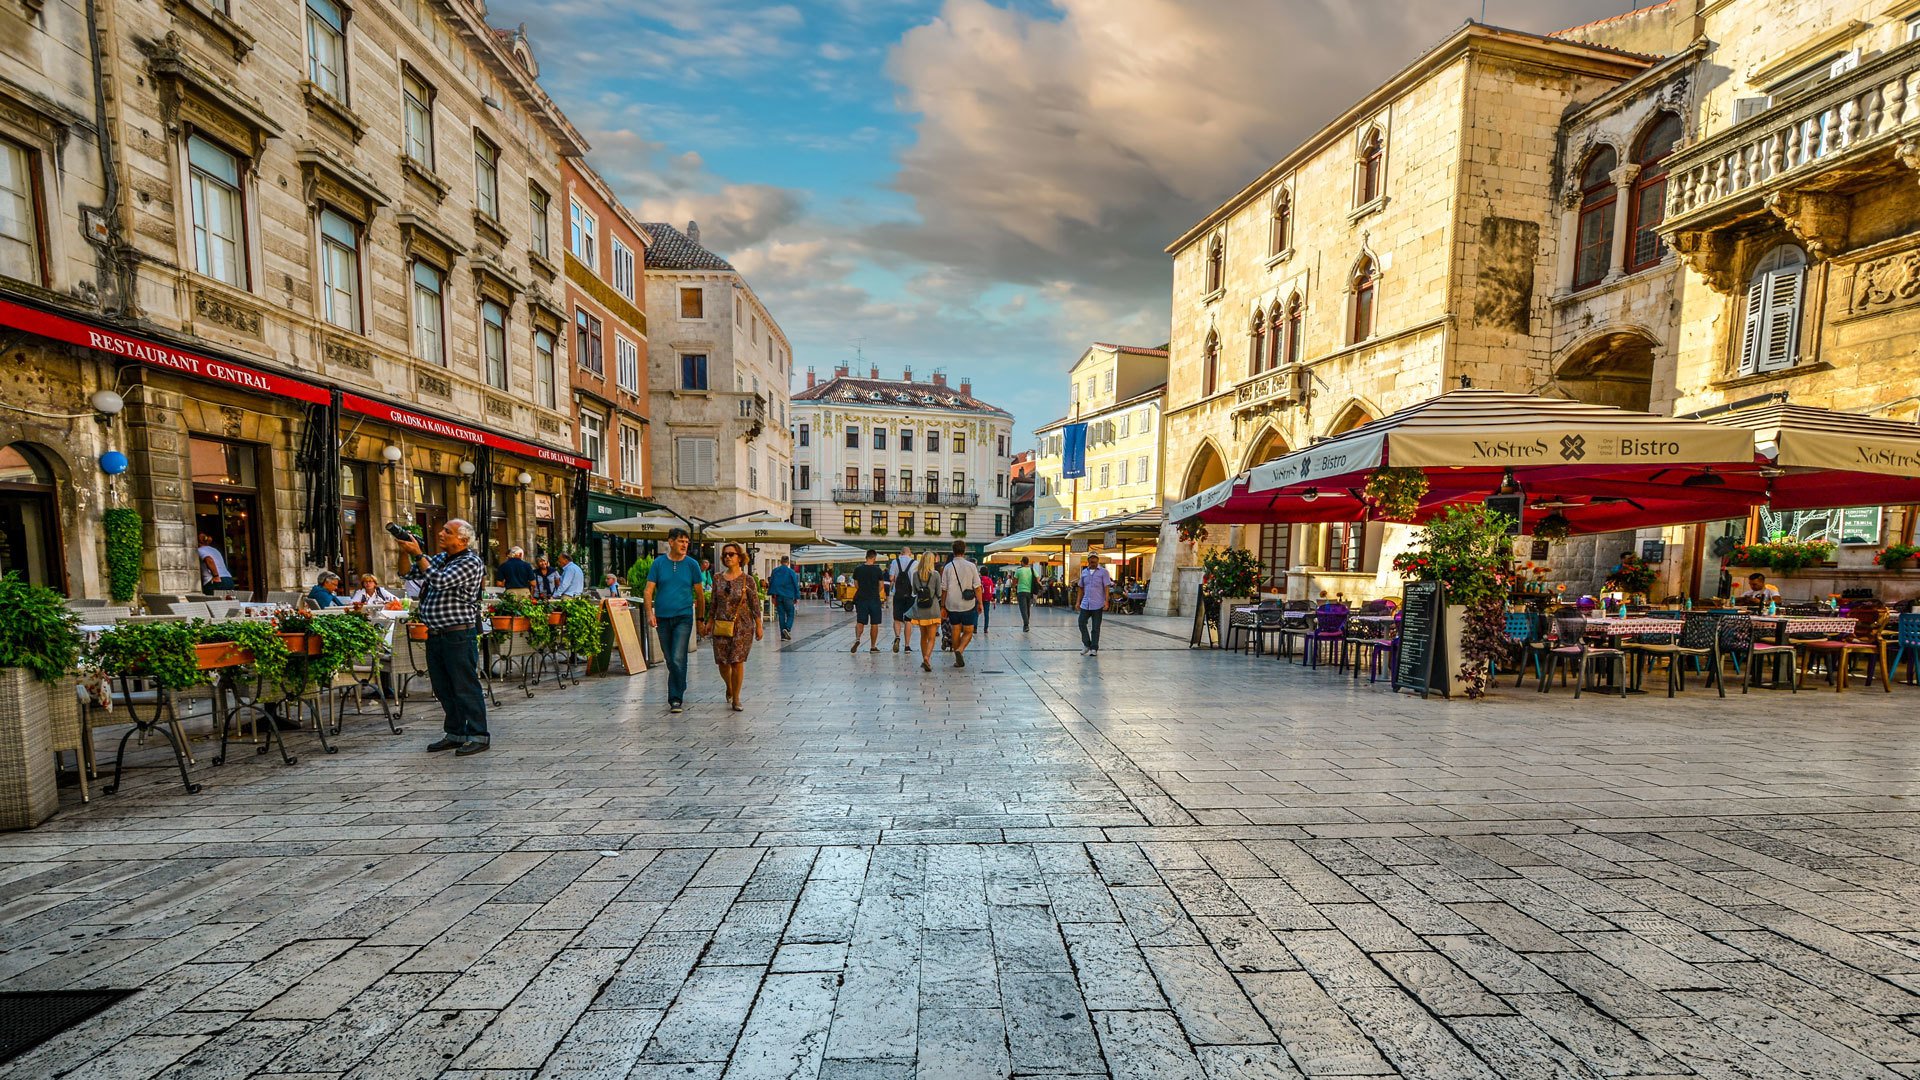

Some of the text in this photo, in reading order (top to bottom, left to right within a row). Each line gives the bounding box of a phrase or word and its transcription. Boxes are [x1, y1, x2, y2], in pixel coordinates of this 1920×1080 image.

[88, 331, 271, 391] RESTAURANT CENTRAL
[390, 410, 485, 444] GRADSKA KAVANA CENTRAL
[557, 454, 564, 462] LA
[1472, 437, 1680, 459] NoStreS Bistro
[1321, 455, 1347, 471] Bistro
